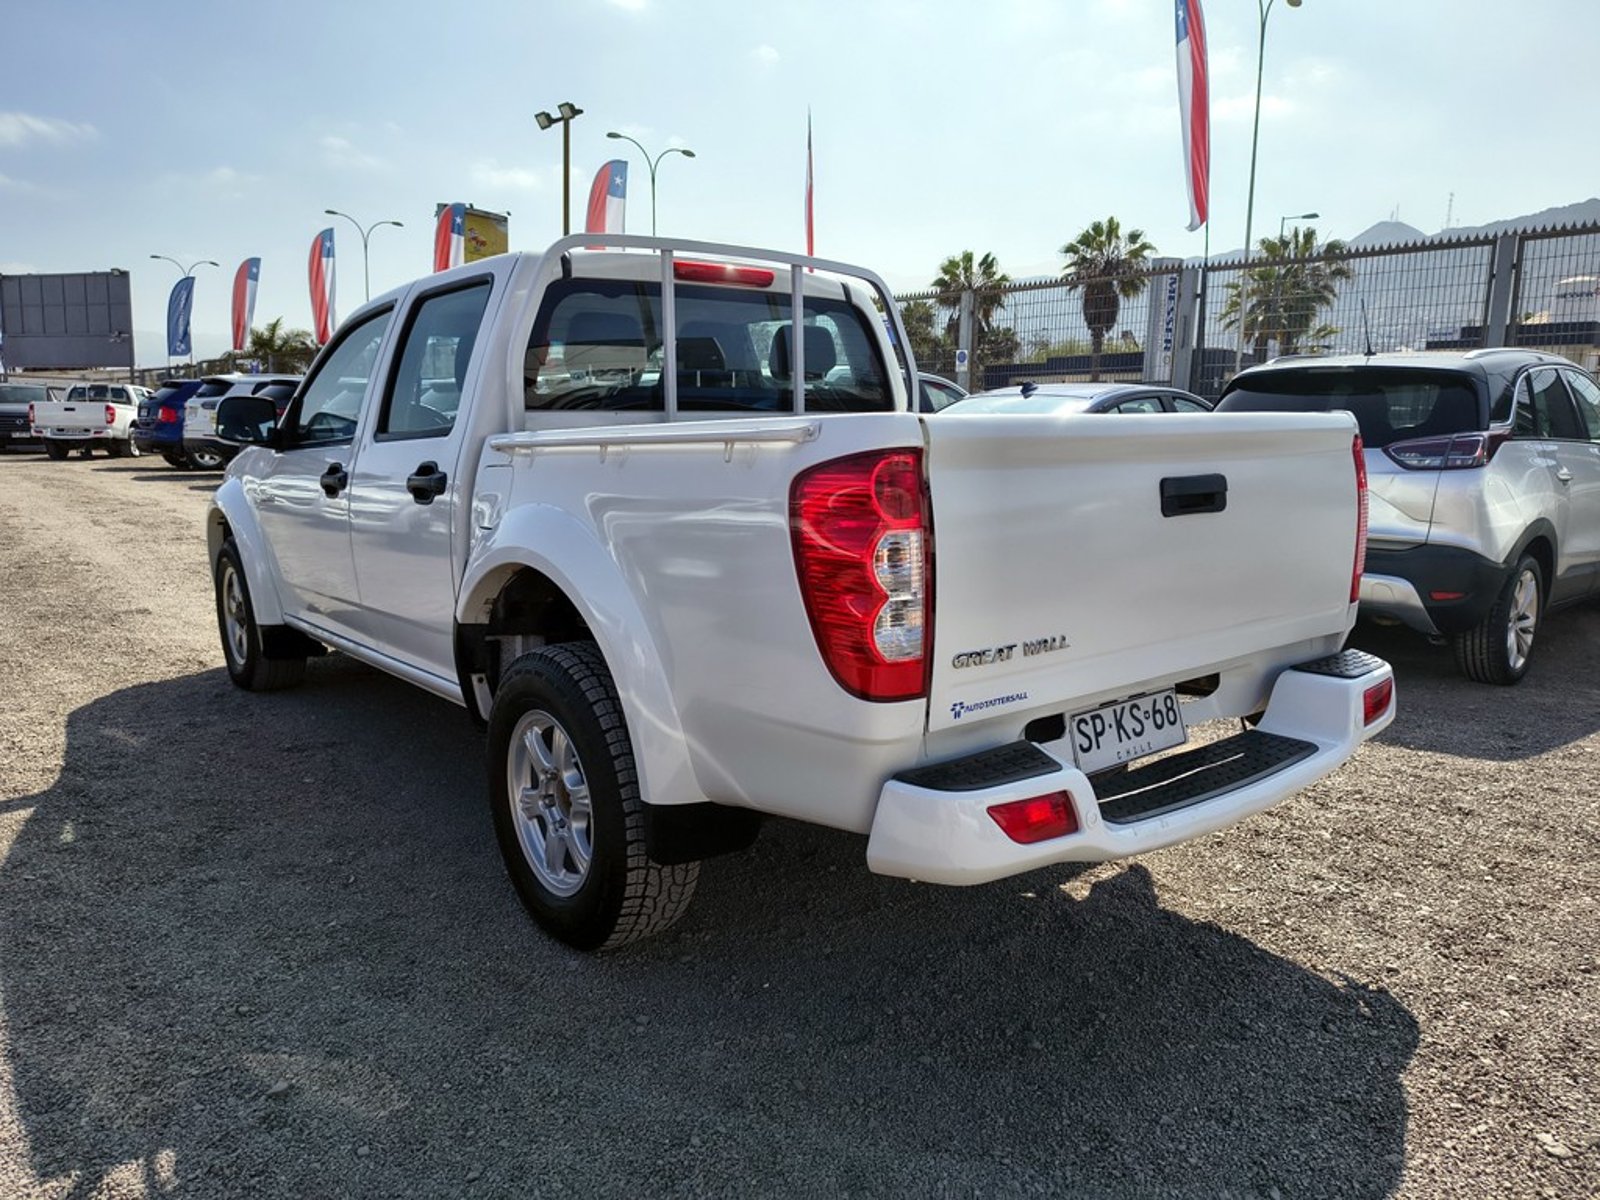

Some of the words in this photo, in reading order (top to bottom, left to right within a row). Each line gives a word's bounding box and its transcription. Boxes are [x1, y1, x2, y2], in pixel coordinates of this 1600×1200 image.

[1163, 274, 1178, 352] MESSER
[951, 643, 1018, 670] GREAT
[1022, 634, 1071, 657] WALL
[1116, 741, 1153, 760] CHILE
